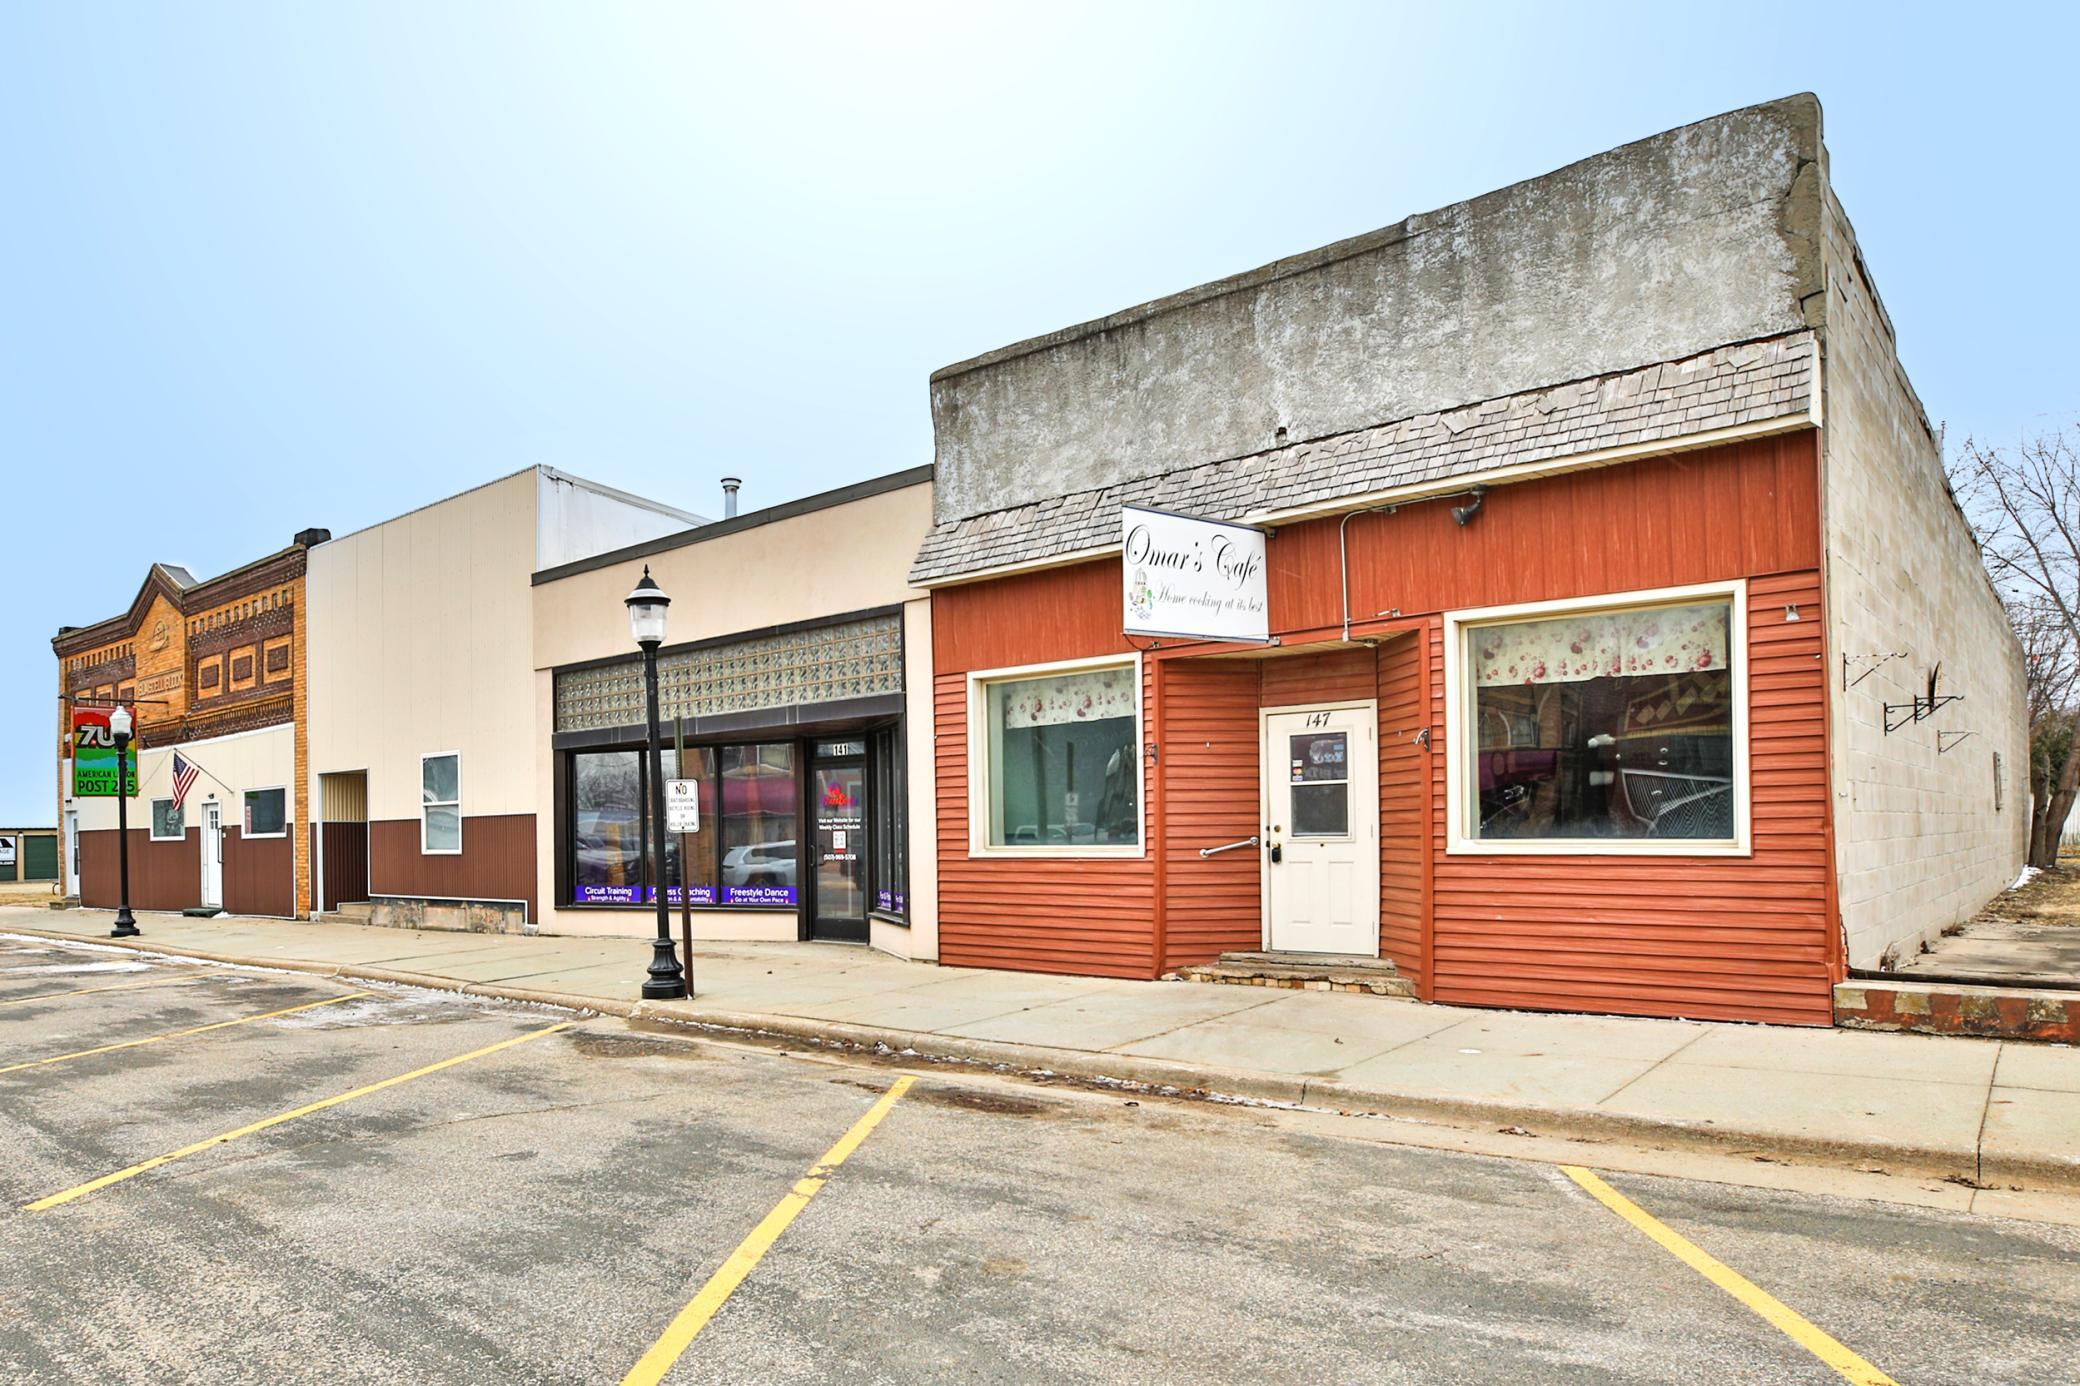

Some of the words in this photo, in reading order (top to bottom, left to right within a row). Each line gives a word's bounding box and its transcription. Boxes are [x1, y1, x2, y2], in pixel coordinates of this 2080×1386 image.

[1126, 524, 1202, 572] Omar's
[1211, 534, 1262, 591] Café
[1189, 591, 1221, 616] cooking
[1225, 598, 1234, 609] at
[1306, 712, 1331, 728] 147
[80, 725, 133, 748] 7U
[834, 744, 848, 755] 141
[78, 770, 112, 778] AMERICAN
[78, 780, 109, 792] POST
[111, 780, 135, 792] 25
[675, 785, 687, 795] NO
[585, 887, 606, 895] Circuit
[607, 887, 632, 897] Training
[730, 888, 763, 897] Freestyle
[764, 888, 789, 897] Dance
